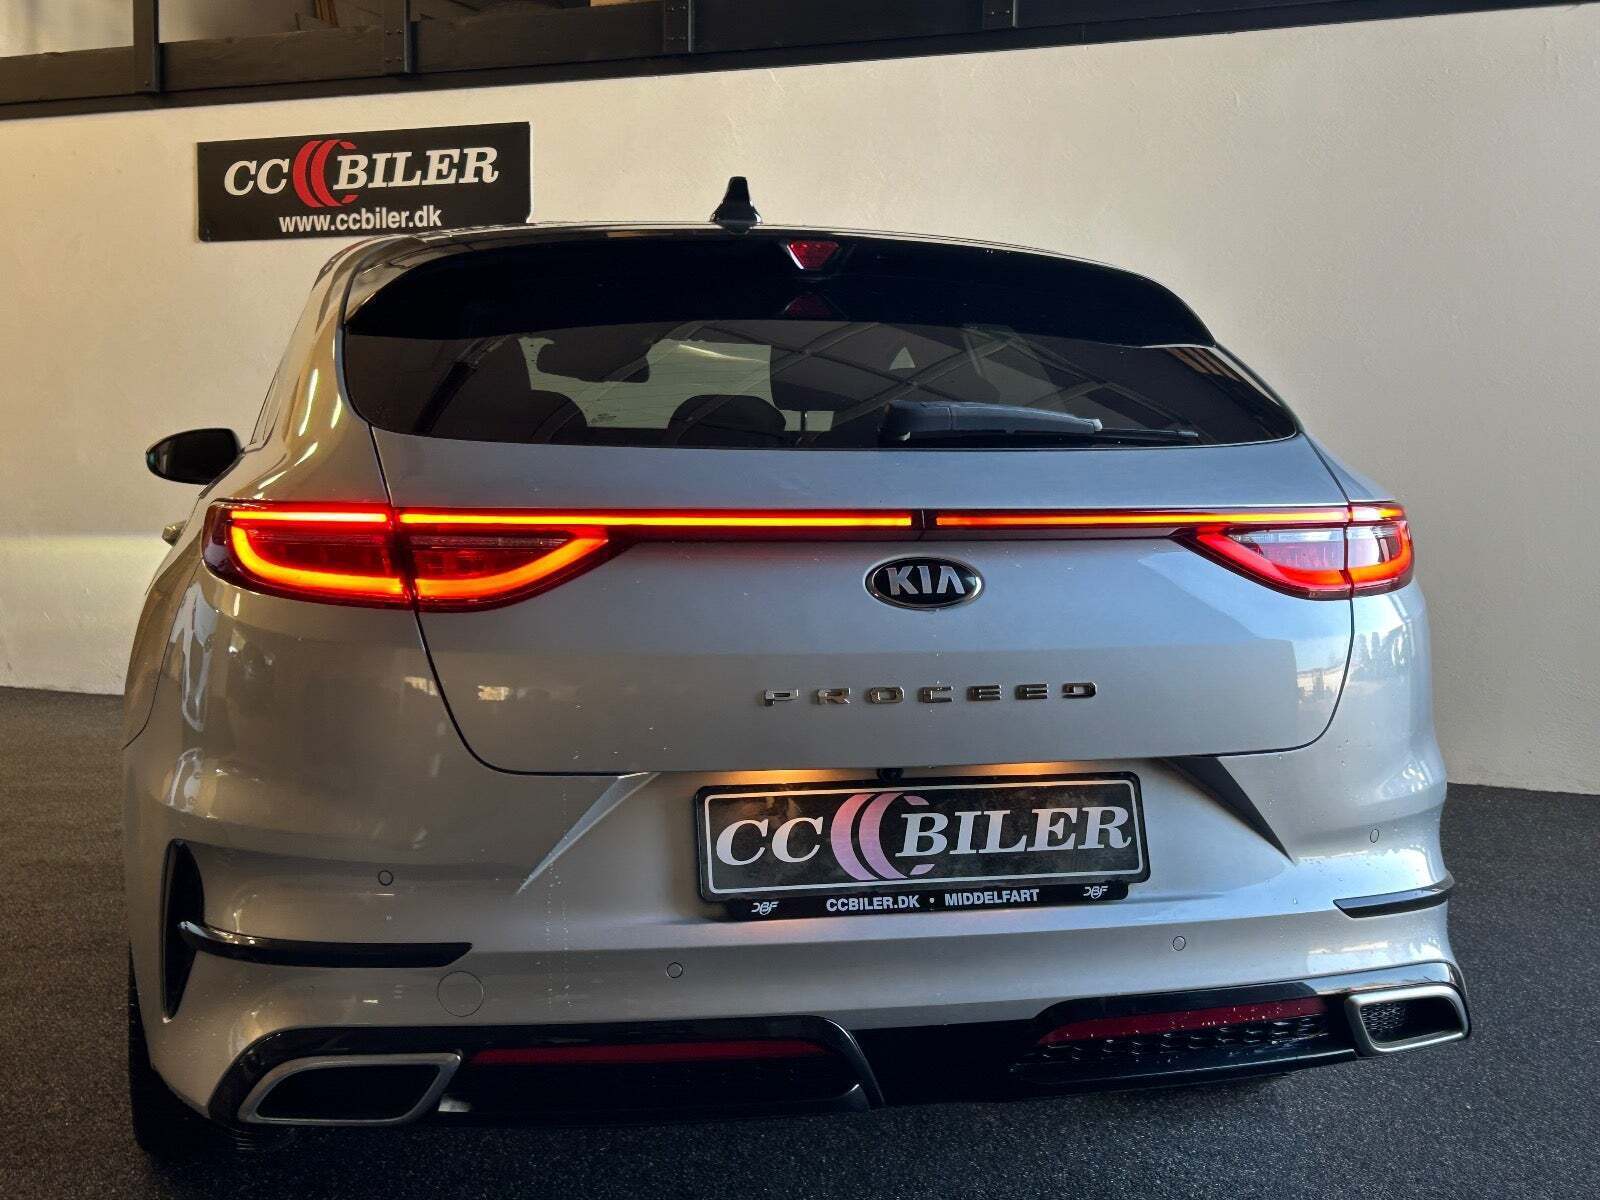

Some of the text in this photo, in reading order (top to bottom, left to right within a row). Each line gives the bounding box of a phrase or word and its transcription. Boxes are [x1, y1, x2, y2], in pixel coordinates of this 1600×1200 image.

[332, 146, 500, 191] BILER
[278, 205, 443, 233] www.ccbiler.dk
[886, 565, 966, 596] KIA
[763, 681, 1098, 706] PROCEED
[895, 805, 1133, 857] BILER
[825, 888, 1040, 912] CCBILER.DK MIDDELFART
